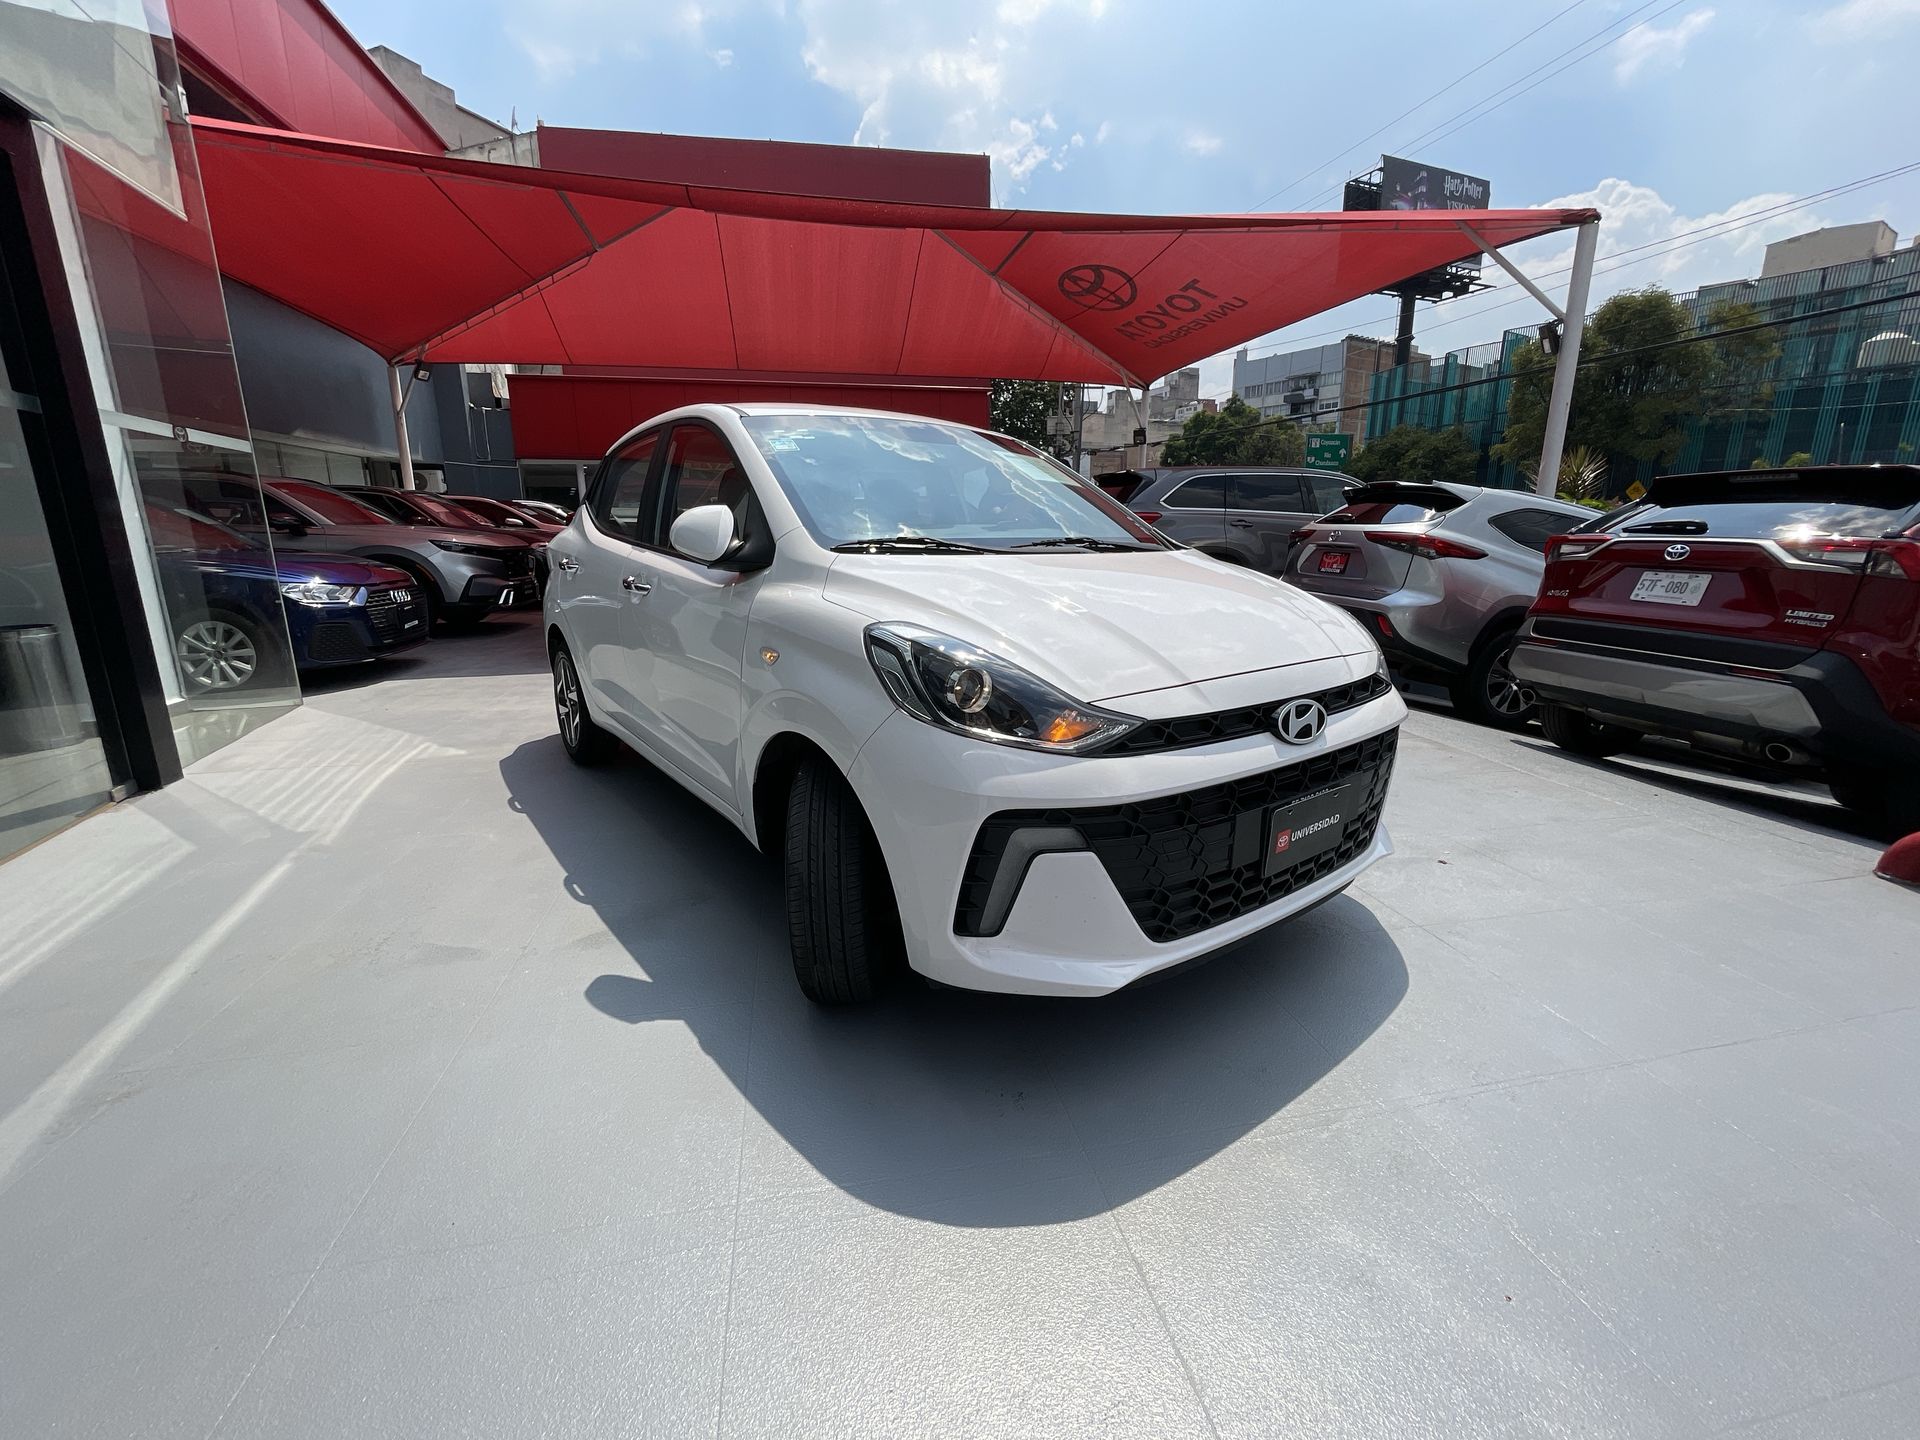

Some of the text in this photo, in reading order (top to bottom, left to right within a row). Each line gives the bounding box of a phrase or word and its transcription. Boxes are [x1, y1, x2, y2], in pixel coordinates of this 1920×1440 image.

[1444, 175, 1483, 200] Harry Potter
[1637, 578, 1689, 595] 57F-080
[1785, 609, 1835, 620] LIMITED
[1291, 814, 1340, 842] UNIVERSIDAD
